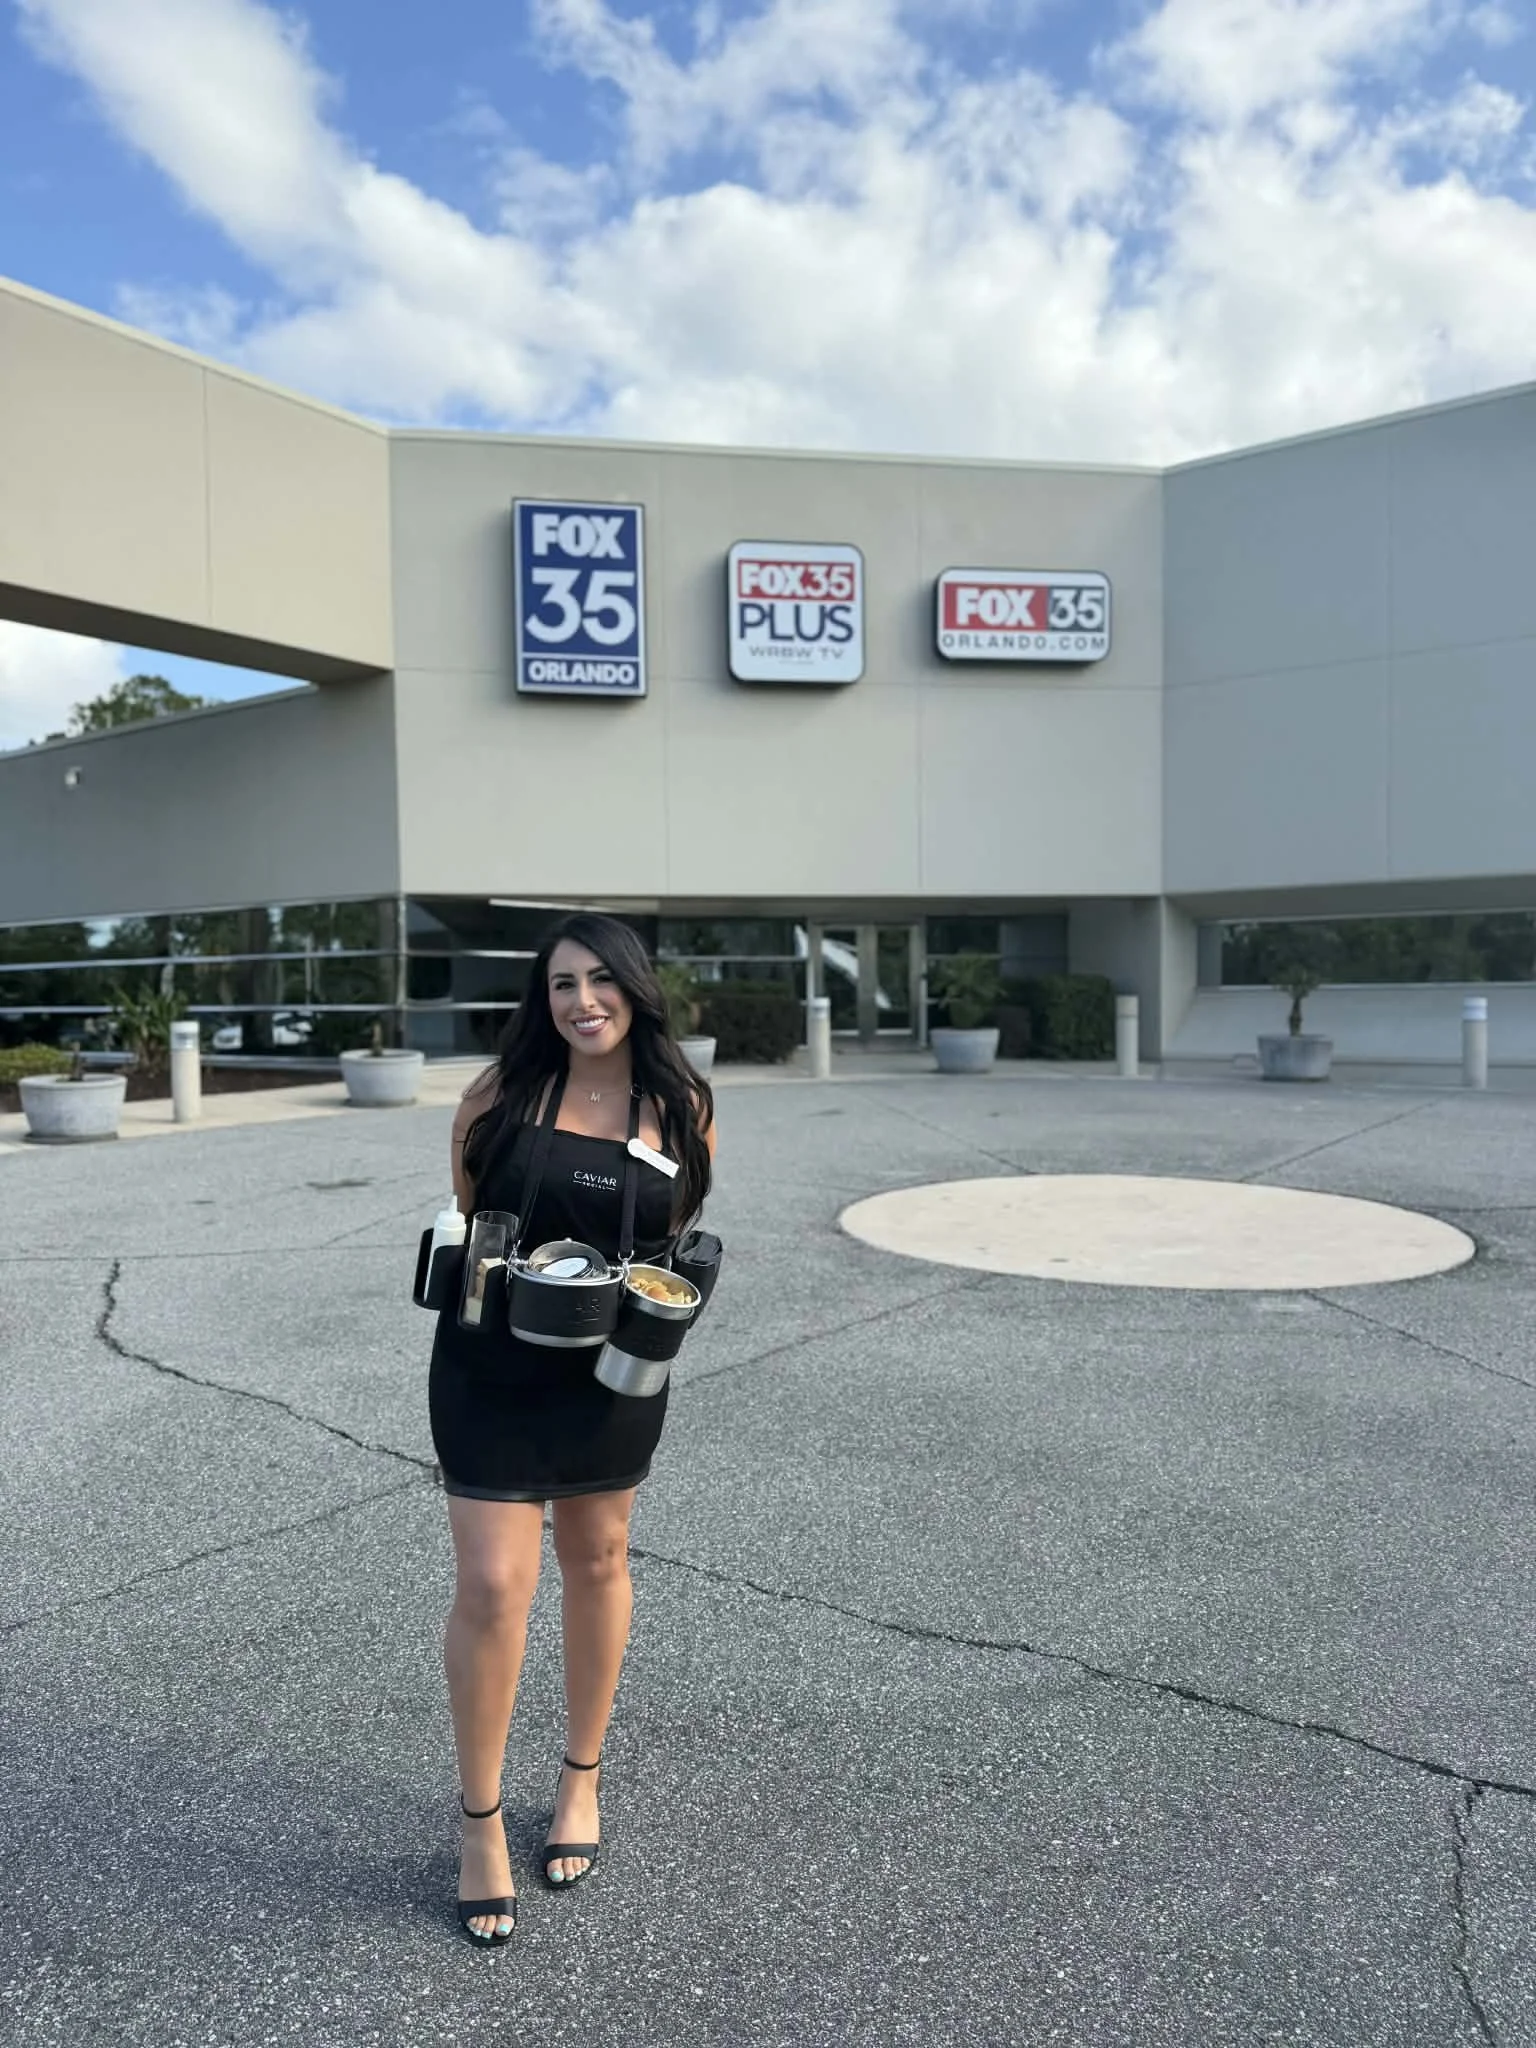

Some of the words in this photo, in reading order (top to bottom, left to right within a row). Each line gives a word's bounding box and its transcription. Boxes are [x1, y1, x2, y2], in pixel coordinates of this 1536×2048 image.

[533, 514, 624, 558] FOX
[526, 568, 636, 644] 35
[956, 588, 1035, 626] FOX
[1049, 588, 1104, 628] 35
[739, 603, 854, 643] PLUS
[749, 645, 813, 658] WRBW
[818, 647, 845, 660] TV
[942, 634, 1105, 650] ORLANDO.COM
[529, 661, 635, 685] ORLANDO
[574, 1170, 617, 1187] CAVIAR
